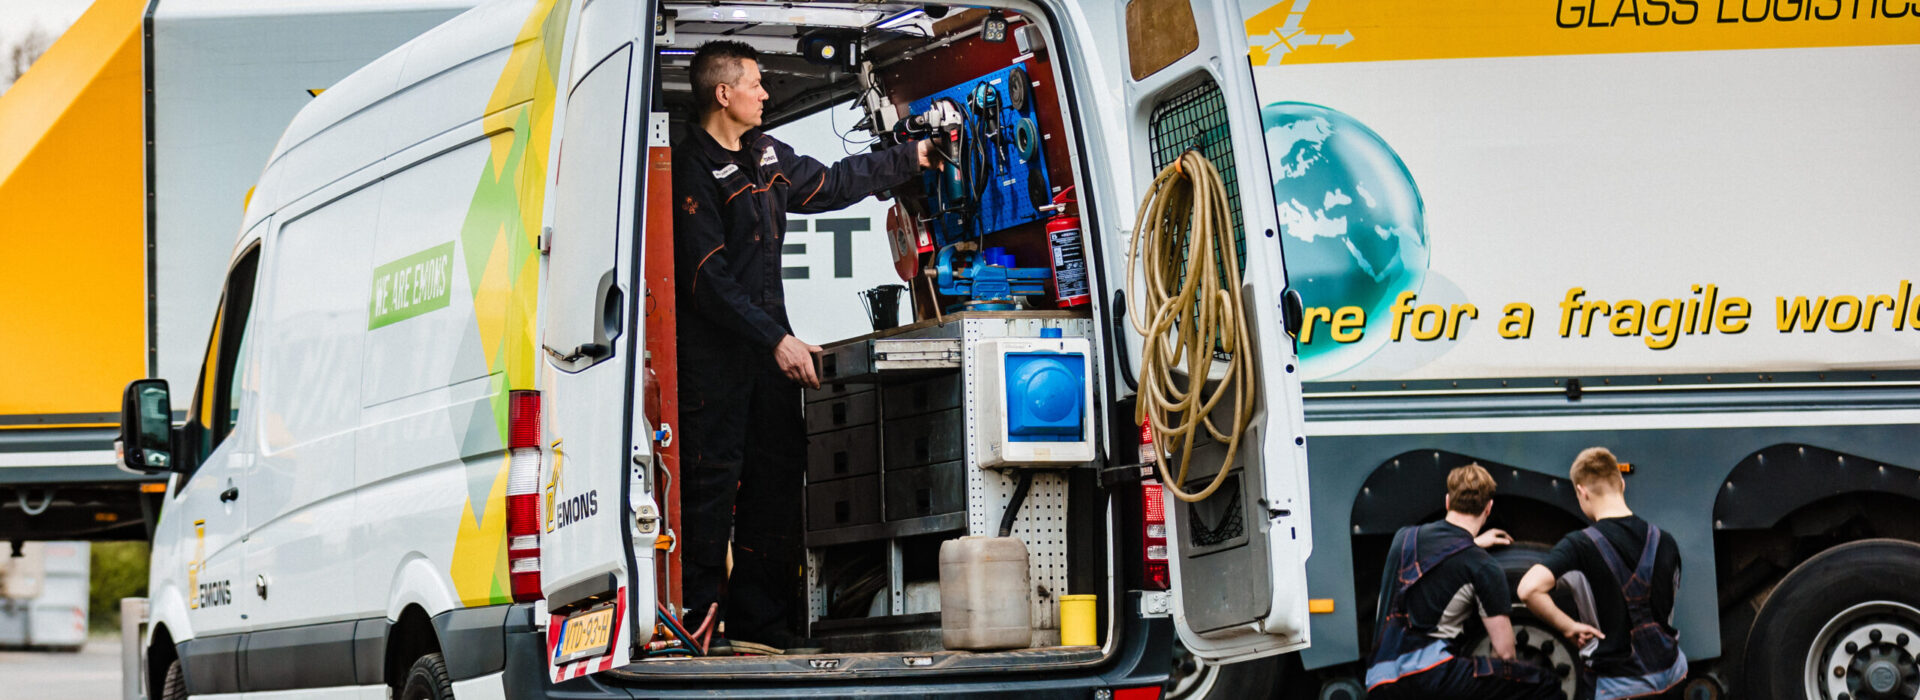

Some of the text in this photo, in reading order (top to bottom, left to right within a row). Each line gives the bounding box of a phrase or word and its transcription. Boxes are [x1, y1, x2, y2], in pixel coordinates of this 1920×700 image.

[1556, 0, 1699, 29] GLASS
[375, 254, 448, 317] WE ARE EMONS
[1389, 290, 1479, 343] for
[1497, 301, 1535, 339] a
[1558, 283, 1752, 351] fragile
[556, 489, 598, 530] EMONS
[200, 579, 231, 608] EMONS
[565, 613, 609, 651] VTD-93-H
